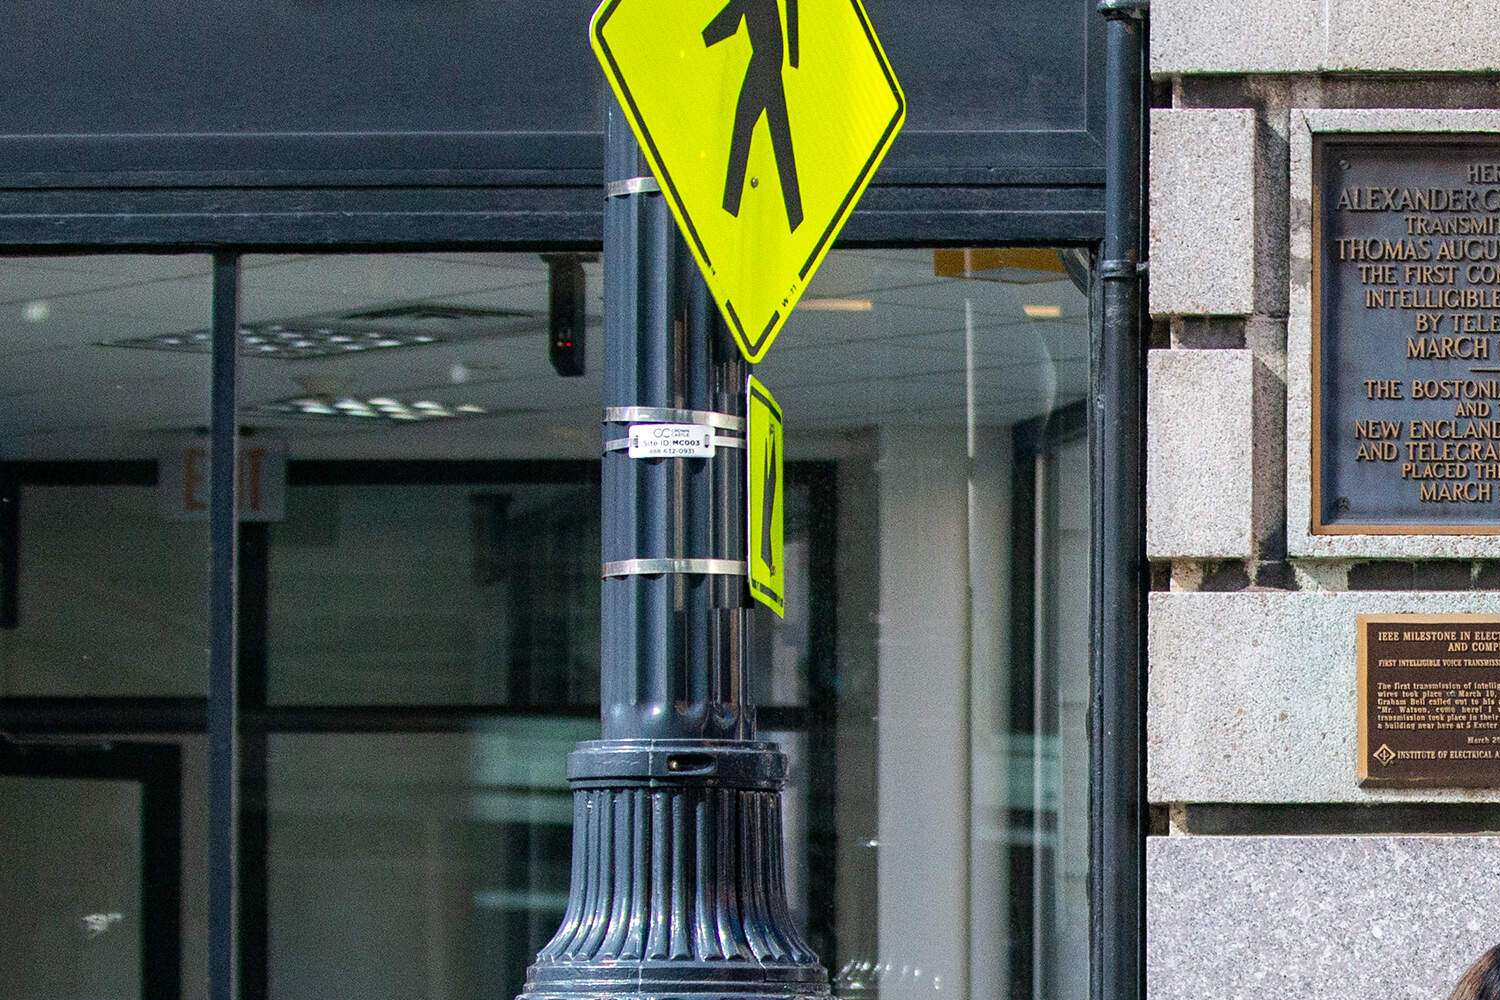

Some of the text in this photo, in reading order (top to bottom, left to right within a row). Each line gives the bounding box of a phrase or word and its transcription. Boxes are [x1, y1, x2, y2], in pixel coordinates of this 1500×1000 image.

[1336, 189, 1478, 211] ALEXANDER
[1338, 240, 1430, 261] THOMAS
[1359, 266, 1396, 284] THE
[1405, 266, 1458, 284] FIRST
[1417, 315, 1443, 332] BY
[1407, 338, 1488, 358] MARCH
[1365, 381, 1402, 398] THE
[1455, 403, 1489, 417] AND
[1354, 421, 1400, 438] NEW
[1356, 443, 1396, 460] AND
[1402, 464, 1467, 479] PLACED
[1420, 483, 1490, 501] MARCH
[1378, 631, 1399, 641] IEEE
[1403, 631, 1457, 641] MILESTONE
[1460, 631, 1471, 641] IN
[1448, 642, 1468, 652] AND
[1378, 659, 1396, 667] FIRST
[1399, 659, 1440, 667] INTELLIGIBLE
[1442, 659, 1462, 667] VOICE
[1377, 682, 1391, 690] The
[1394, 682, 1410, 690] first
[1413, 682, 1461, 690] transmission
[1463, 682, 1472, 690] of
[1377, 690, 1398, 698] wires
[1402, 690, 1418, 698] took
[1422, 690, 1442, 699] place
[1458, 690, 1481, 698] March
[1377, 698, 1406, 706] Graham
[1410, 698, 1425, 706] Bell
[1428, 698, 1451, 706] called
[1454, 698, 1467, 706] out
[1471, 698, 1479, 706] to
[1483, 698, 1494, 706] his
[1435, 706, 1456, 714] come
[1447, 714, 1466, 722] place
[1384, 722, 1416, 730] building
[1467, 736, 1489, 744] March
[1397, 751, 1435, 759] INSTITUTE
[1438, 751, 1448, 759] OF
[1450, 751, 1492, 759] ELECTRICAL
